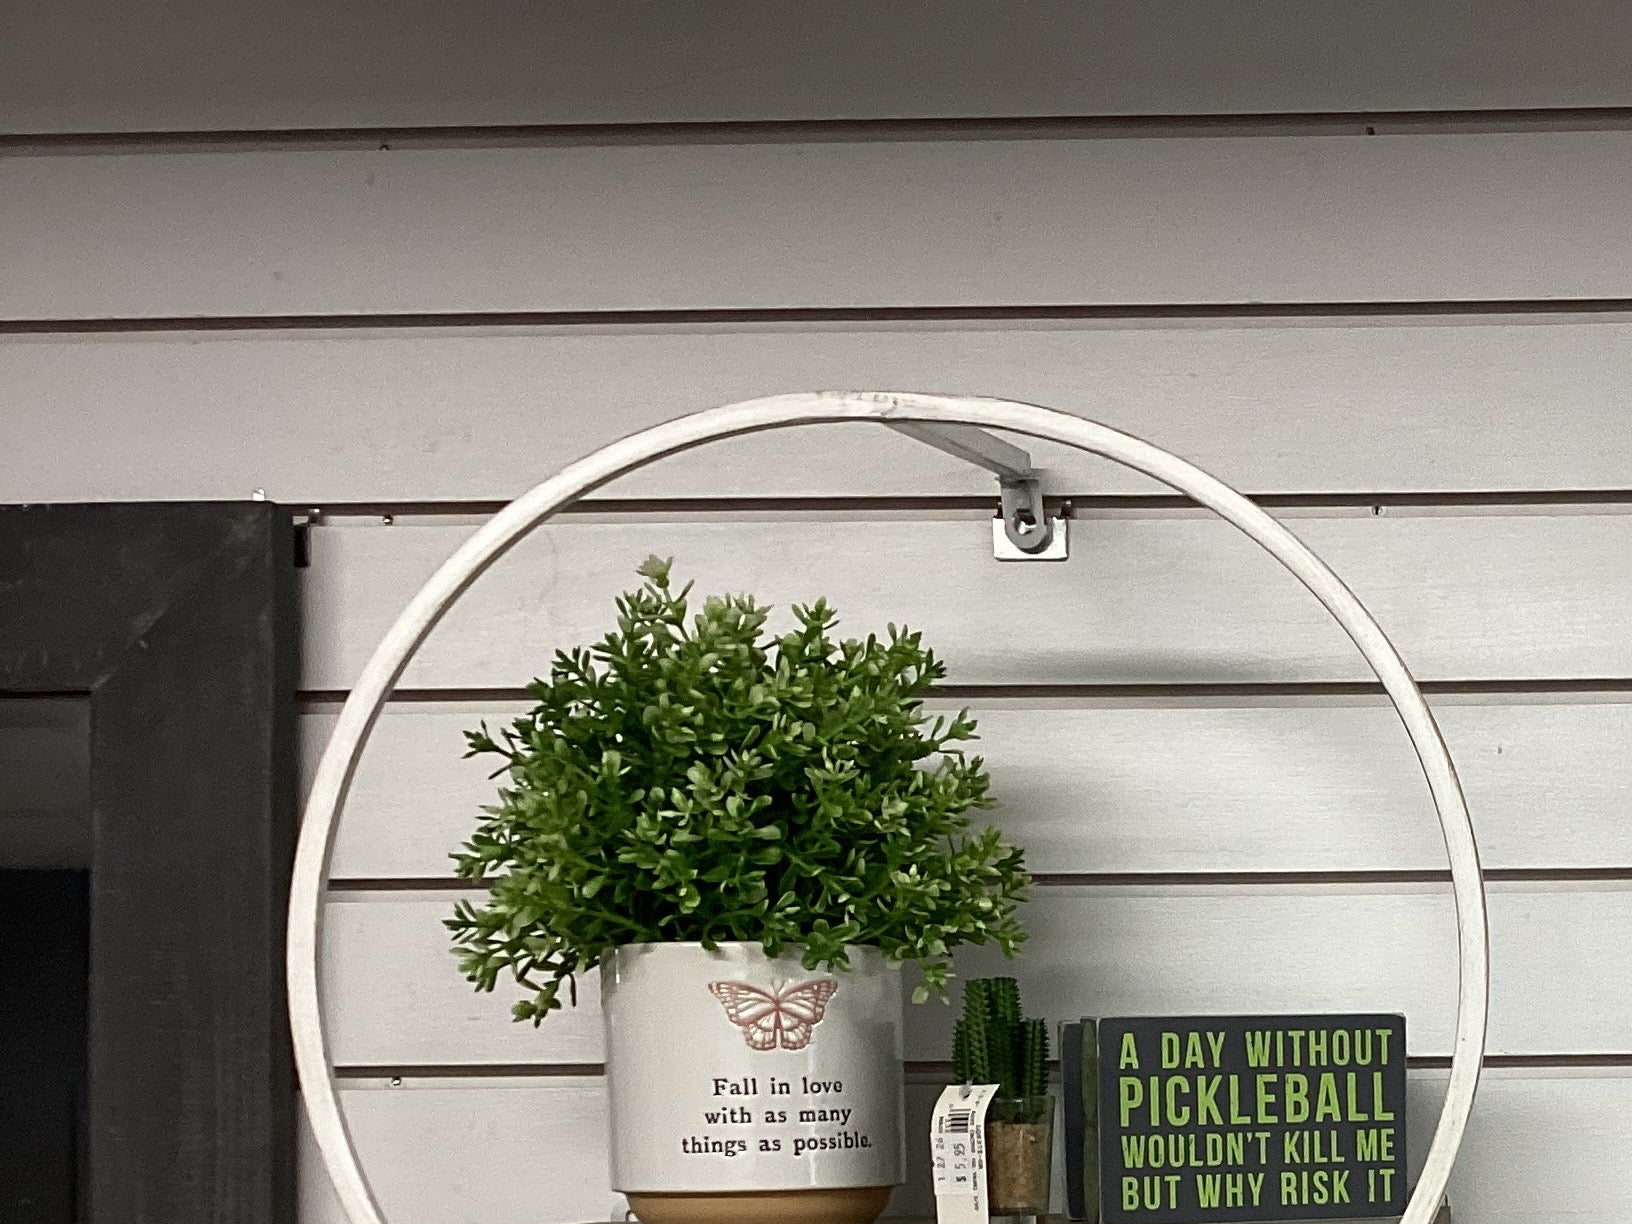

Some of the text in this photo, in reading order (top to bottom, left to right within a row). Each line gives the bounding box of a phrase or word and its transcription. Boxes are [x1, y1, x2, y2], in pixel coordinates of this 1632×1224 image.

[1119, 1029, 1393, 1070] A DAY WITHOUT
[712, 1076, 843, 1096] Fall in love
[1119, 1071, 1395, 1127] PICKLEBALL
[704, 1106, 852, 1126] with as many
[682, 1131, 872, 1157] things as possible.
[1121, 1128, 1396, 1168] WOULDN'T KILL ME
[1122, 1168, 1396, 1211] BUT WHY RISK IT
